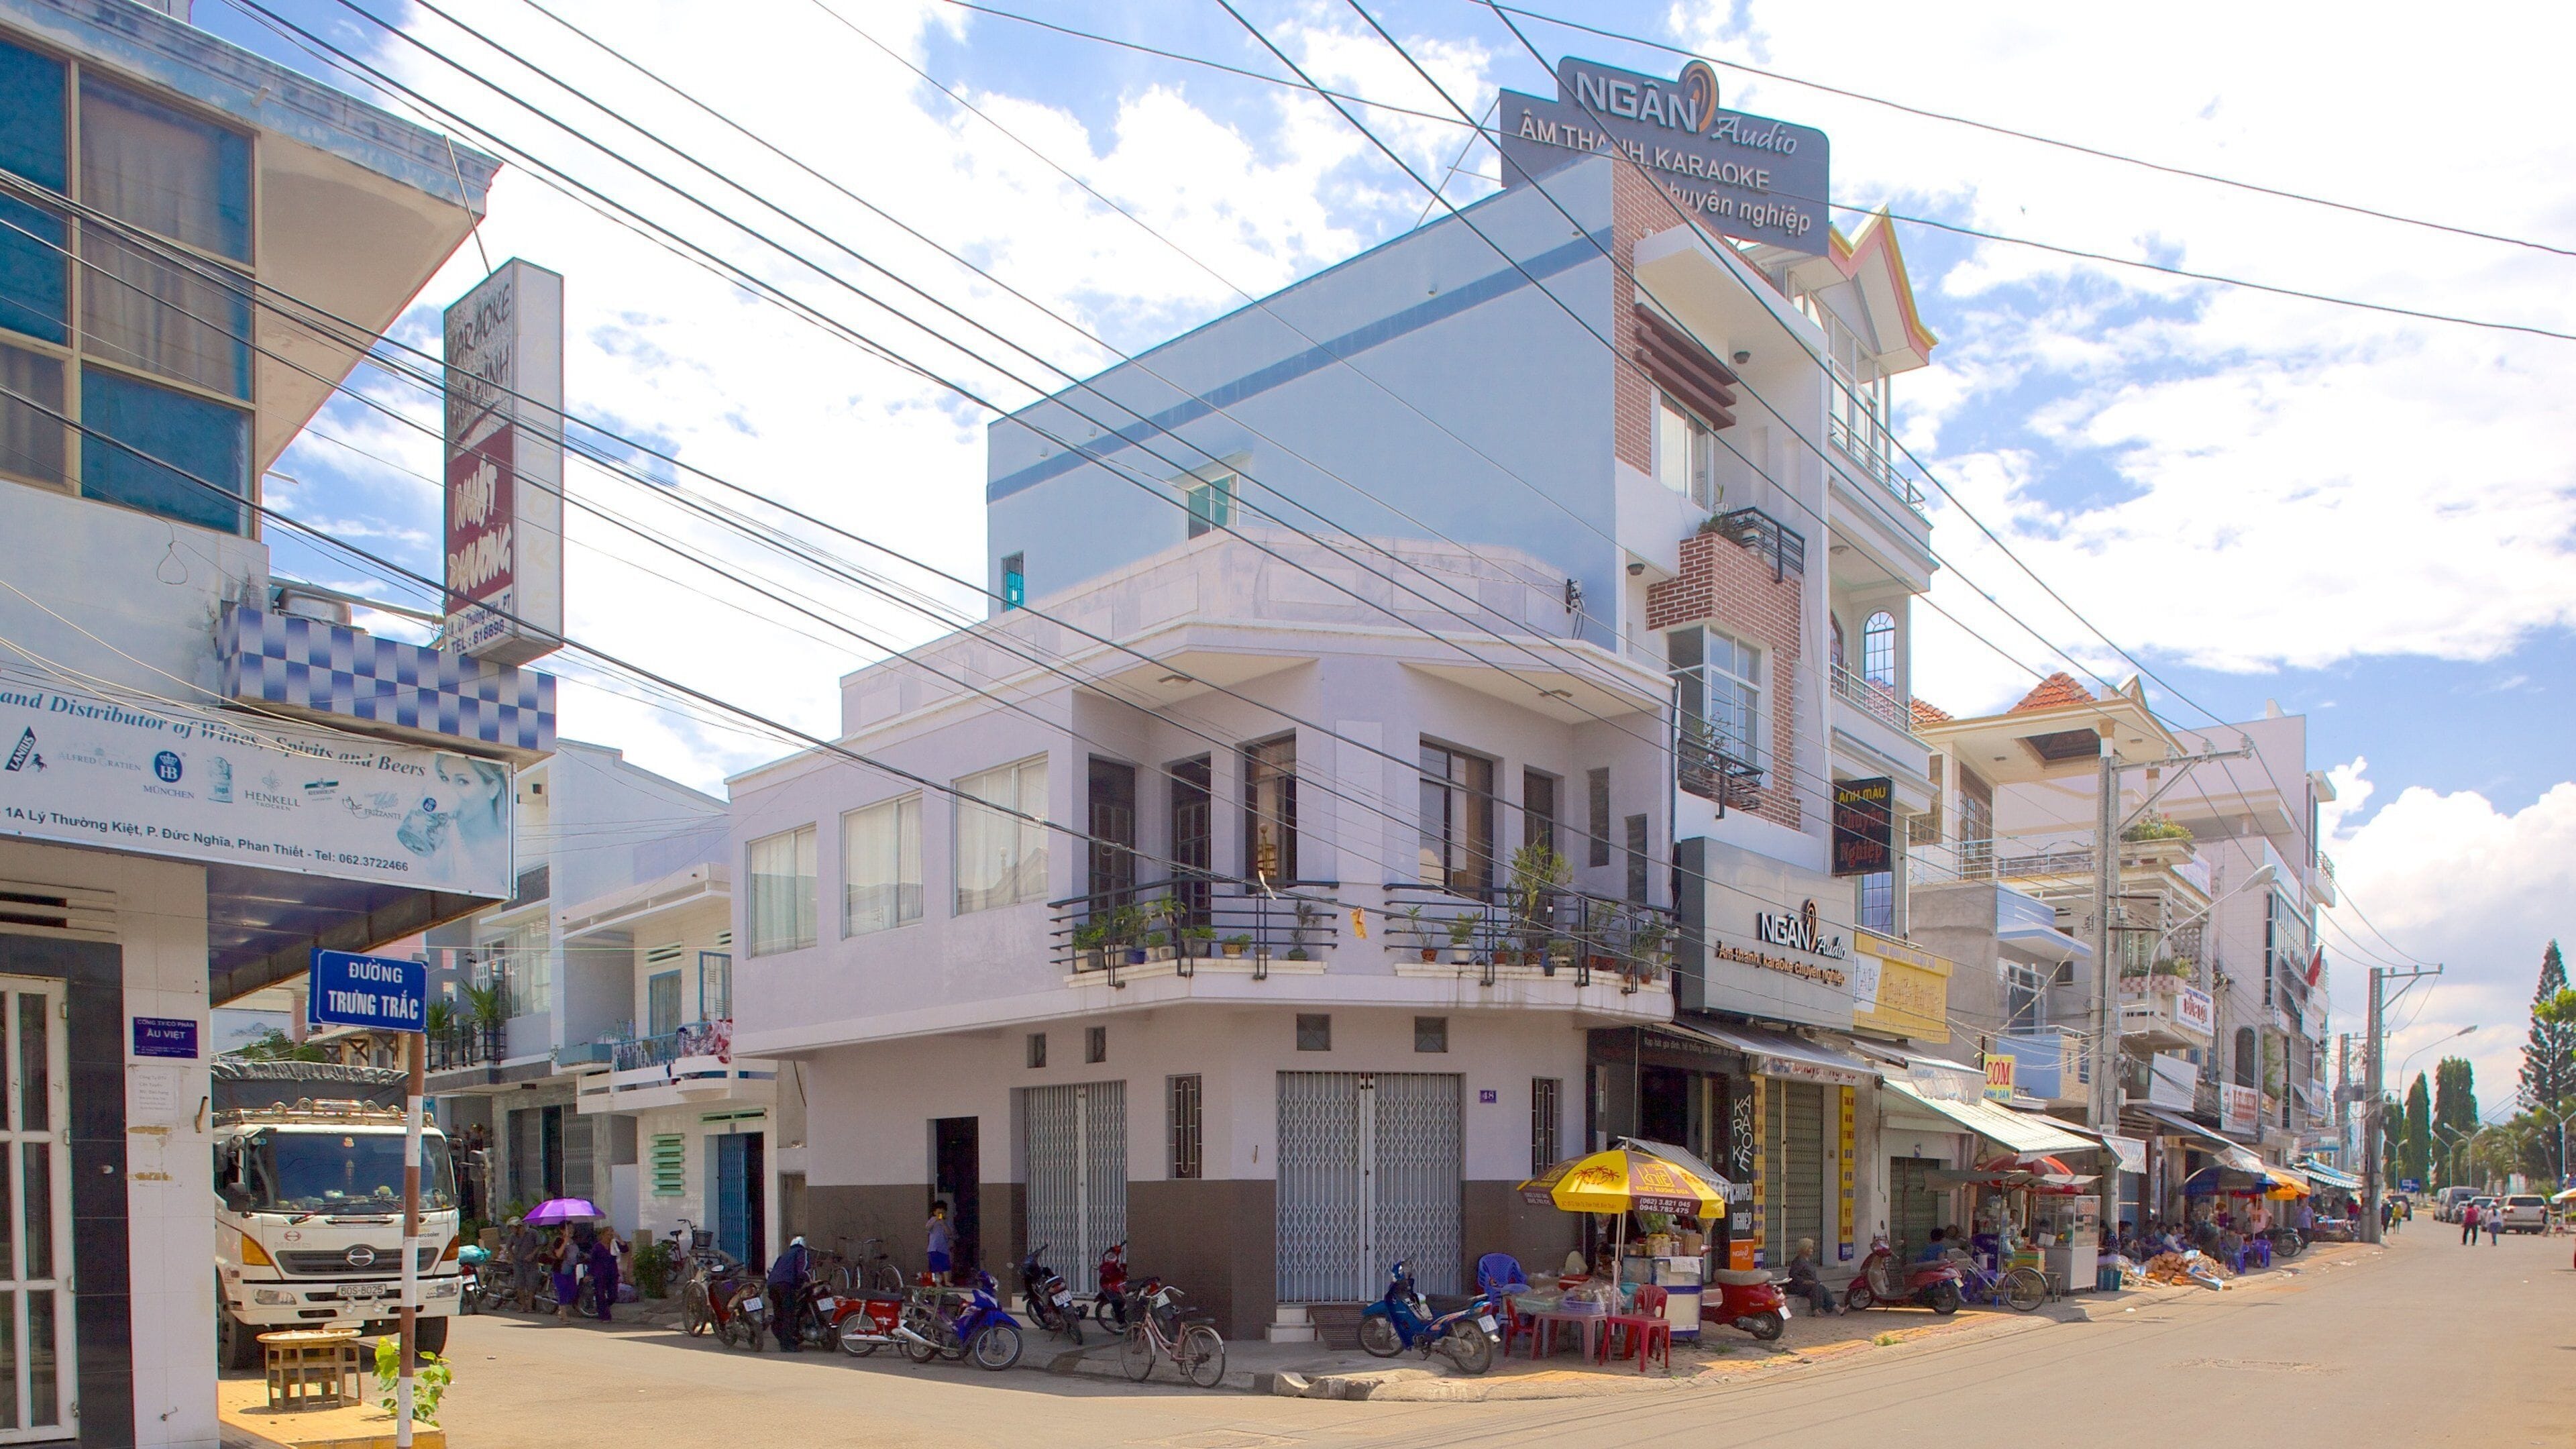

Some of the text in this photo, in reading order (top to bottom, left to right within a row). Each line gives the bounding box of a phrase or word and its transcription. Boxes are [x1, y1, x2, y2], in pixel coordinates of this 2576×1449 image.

[1576, 72, 1797, 155] NGÂN Audio
[1519, 109, 1770, 189] ÂM THAH, KARAOKE
[1669, 180, 1811, 235] huyên nghiệp
[451, 637, 466, 653] TEL
[1, 692, 44, 709] and
[50, 695, 168, 731] Distributor
[173, 721, 198, 739] of
[276, 737, 334, 758] Spirits
[339, 751, 374, 767] and
[378, 755, 426, 777] Beers
[9, 735, 35, 769] LANIUS
[143, 784, 195, 800] MÜNCHEN
[245, 790, 300, 807] HENKELL
[1863, 784, 1886, 800] MÀU
[364, 808, 402, 820] FRIZZANTE
[6, 806, 24, 820] 1A
[29, 809, 46, 824] Lý
[50, 812, 108, 833] Thường
[112, 820, 142, 837] Kiệt,
[147, 825, 158, 837] P.
[162, 828, 190, 841] Đức
[194, 832, 234, 849] Nghĩa,
[239, 839, 270, 853] Phan
[274, 843, 304, 858] Thiết
[315, 850, 335, 862] Tel:
[339, 853, 409, 871] 062.3722466
[1760, 911, 1846, 960] NGÂN Audio
[349, 957, 402, 983] ĐƯỜNG
[1763, 955, 1793, 973] karaoke
[328, 989, 419, 1020] TRƯNG TRẮC
[163, 1030, 186, 1040] VIỆT
[1986, 1058, 2011, 1085] CƠM
[1639, 1205, 1690, 1214] 0945.782.475
[1640, 1197, 1658, 1205] (062)
